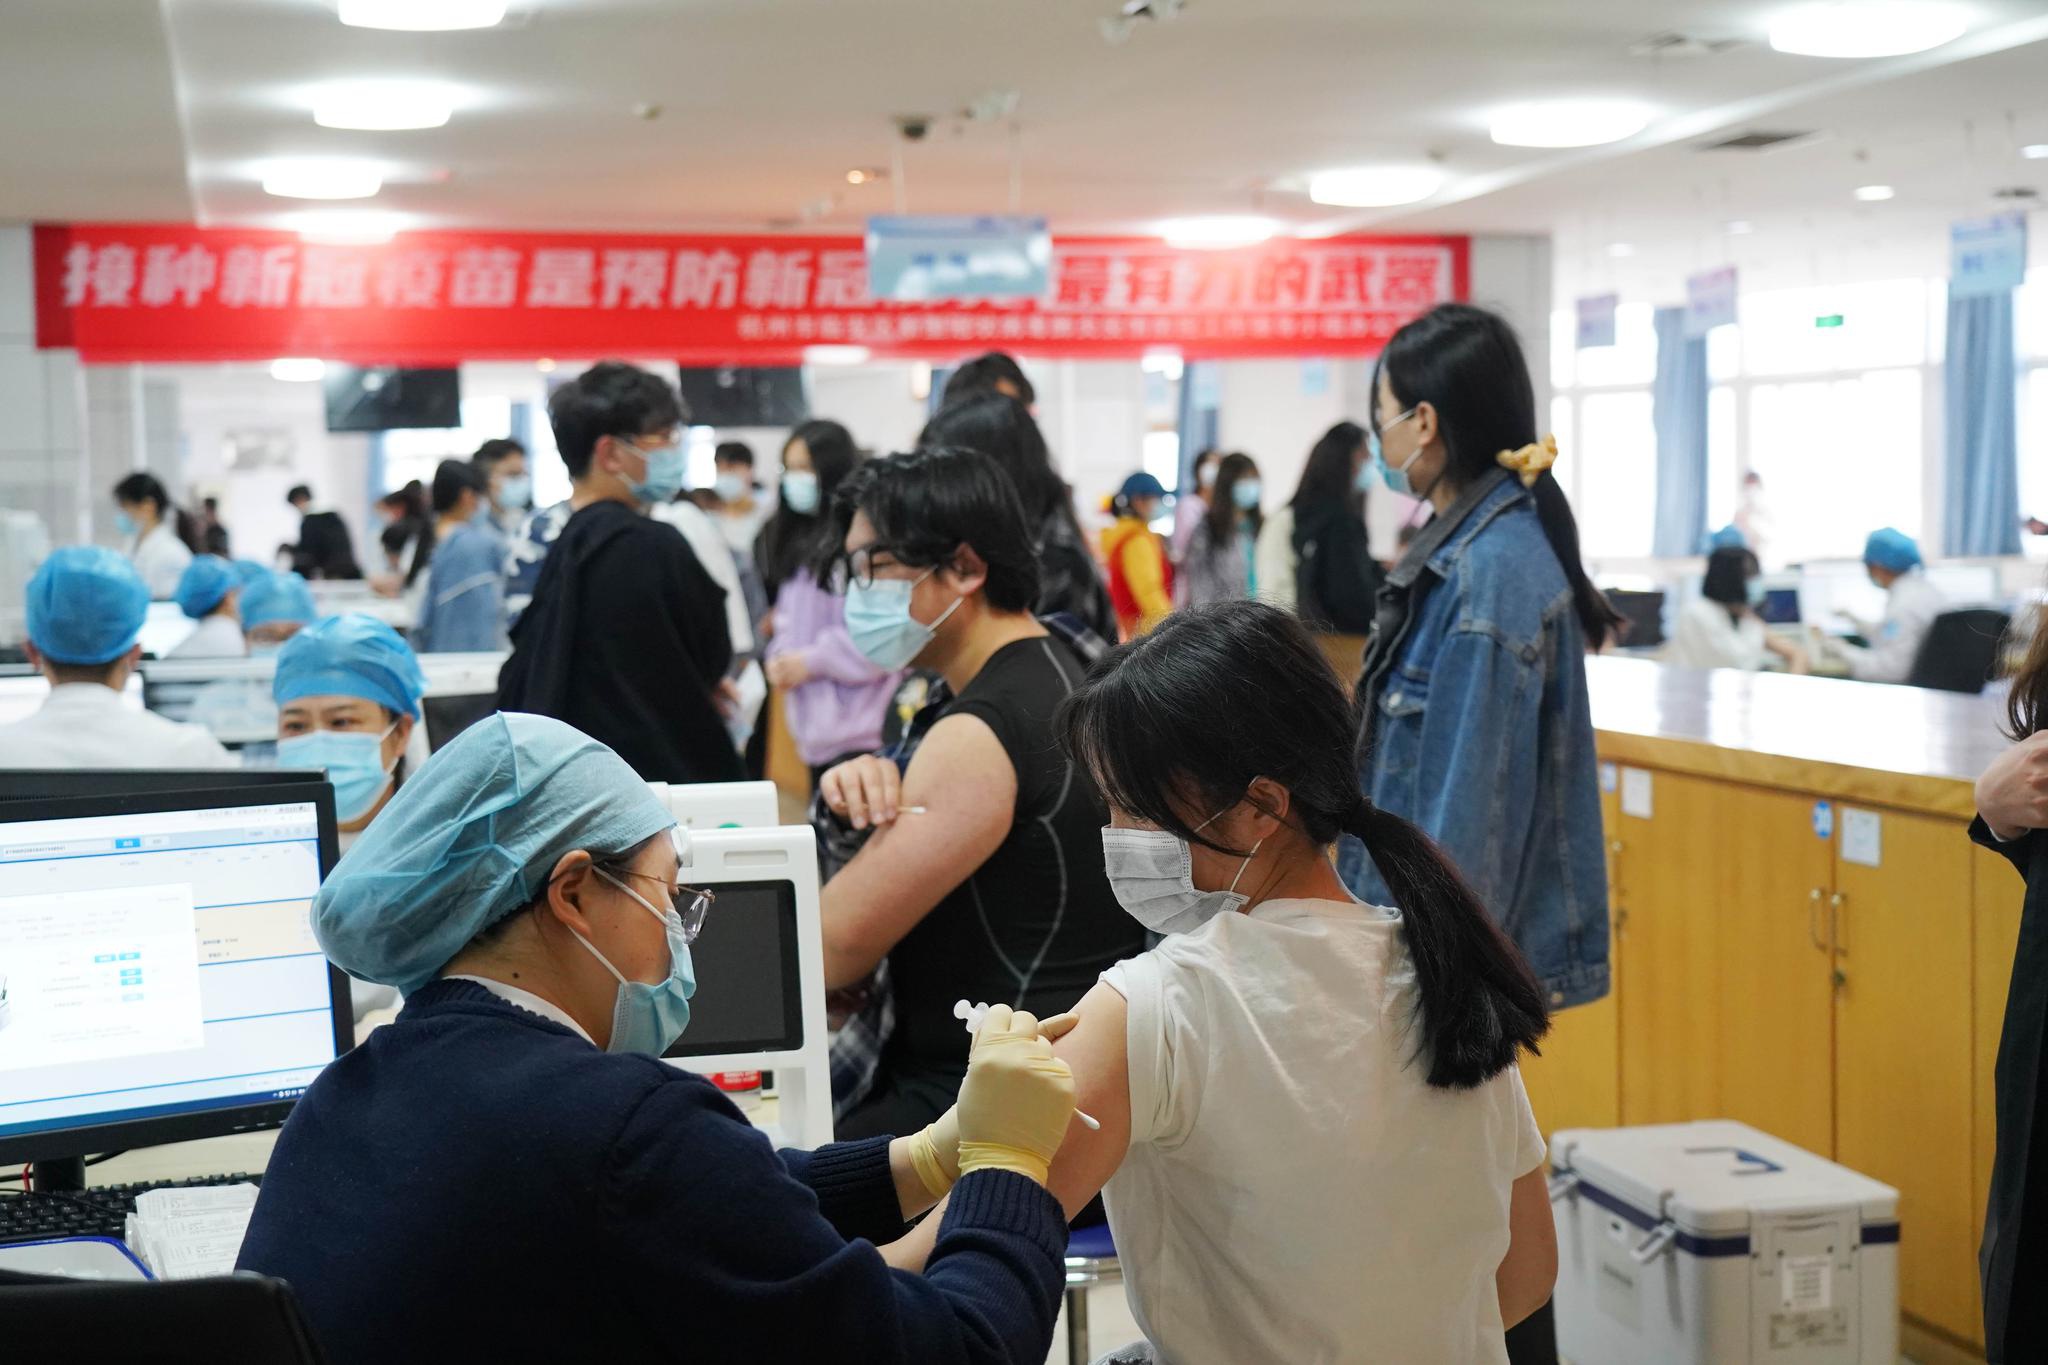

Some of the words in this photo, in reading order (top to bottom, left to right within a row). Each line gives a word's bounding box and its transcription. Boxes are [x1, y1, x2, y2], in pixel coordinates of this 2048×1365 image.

[62, 242, 1449, 310] 接种新冠疫苗是预防新冠最有力的武器
